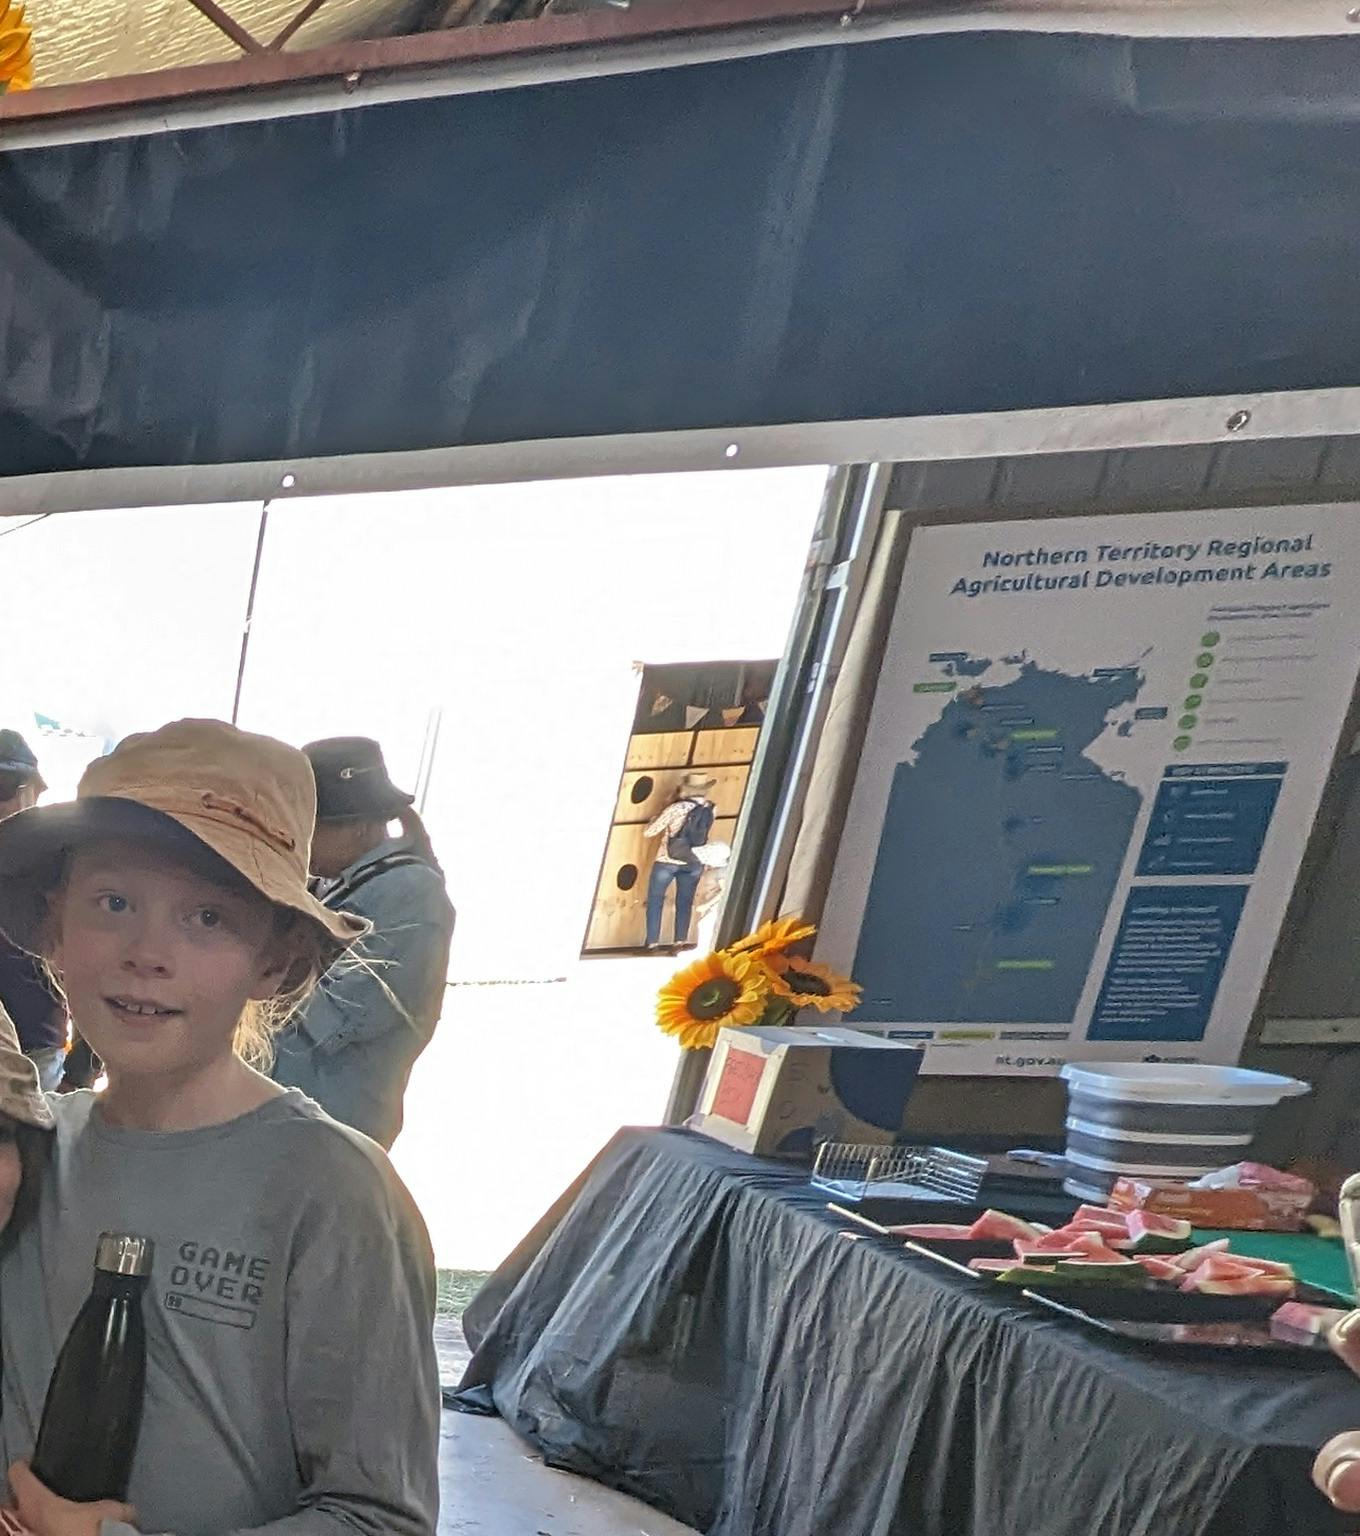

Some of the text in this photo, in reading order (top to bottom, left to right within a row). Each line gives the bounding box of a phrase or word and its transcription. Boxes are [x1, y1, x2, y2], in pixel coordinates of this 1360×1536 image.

[983, 534, 1314, 569] Northern Territory Regional
[950, 559, 1333, 599] Agricultural Development Areas
[179, 1241, 271, 1280] GAME
[171, 1265, 263, 1305] OVER
